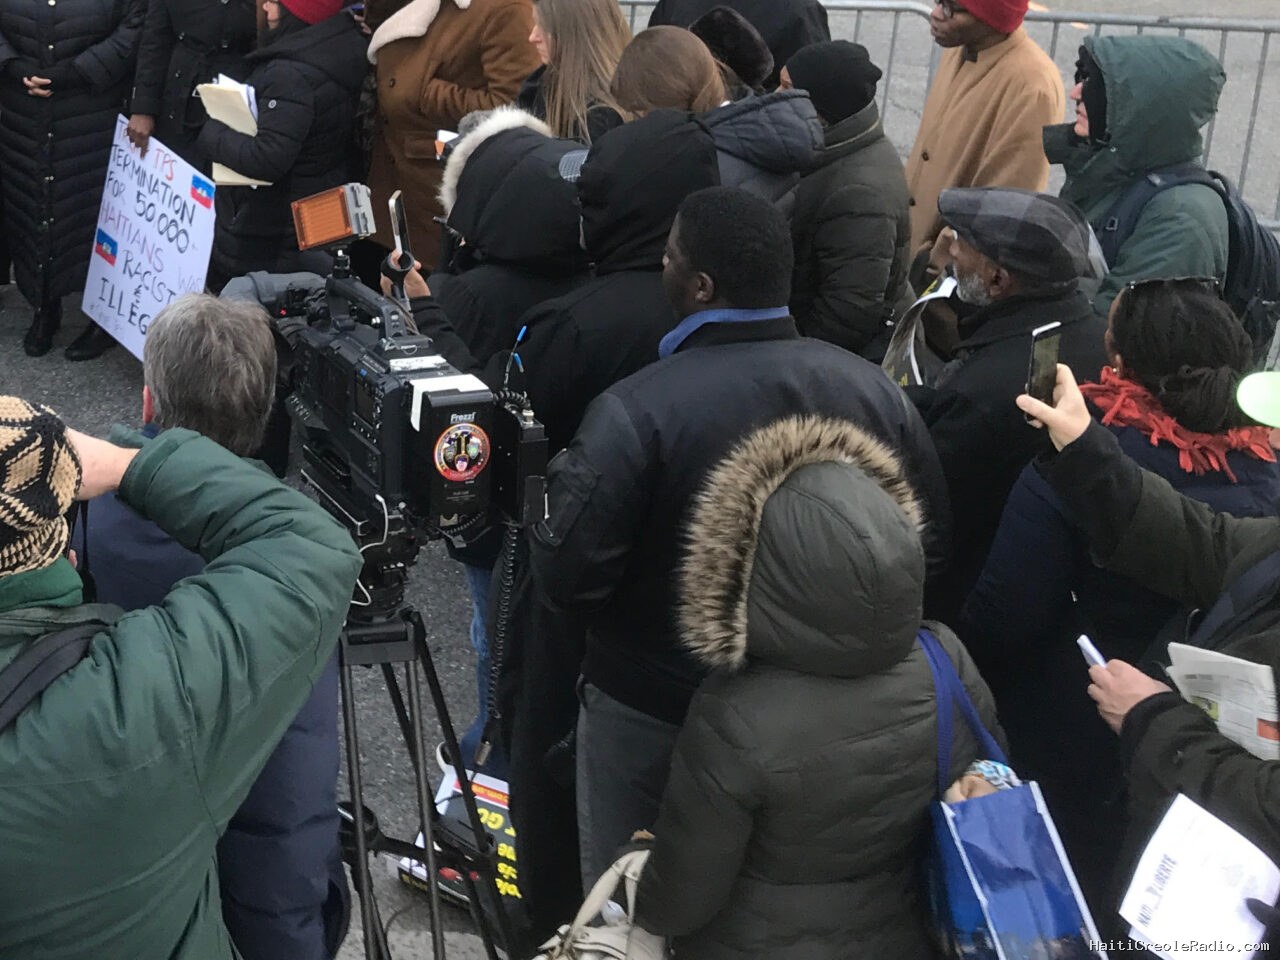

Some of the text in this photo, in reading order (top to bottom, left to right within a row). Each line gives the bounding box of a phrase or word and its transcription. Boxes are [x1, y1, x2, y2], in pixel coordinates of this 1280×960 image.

[111, 142, 196, 227] TERMINATION
[100, 197, 164, 273] HAITIANS
[98, 276, 152, 336] ILLEG
